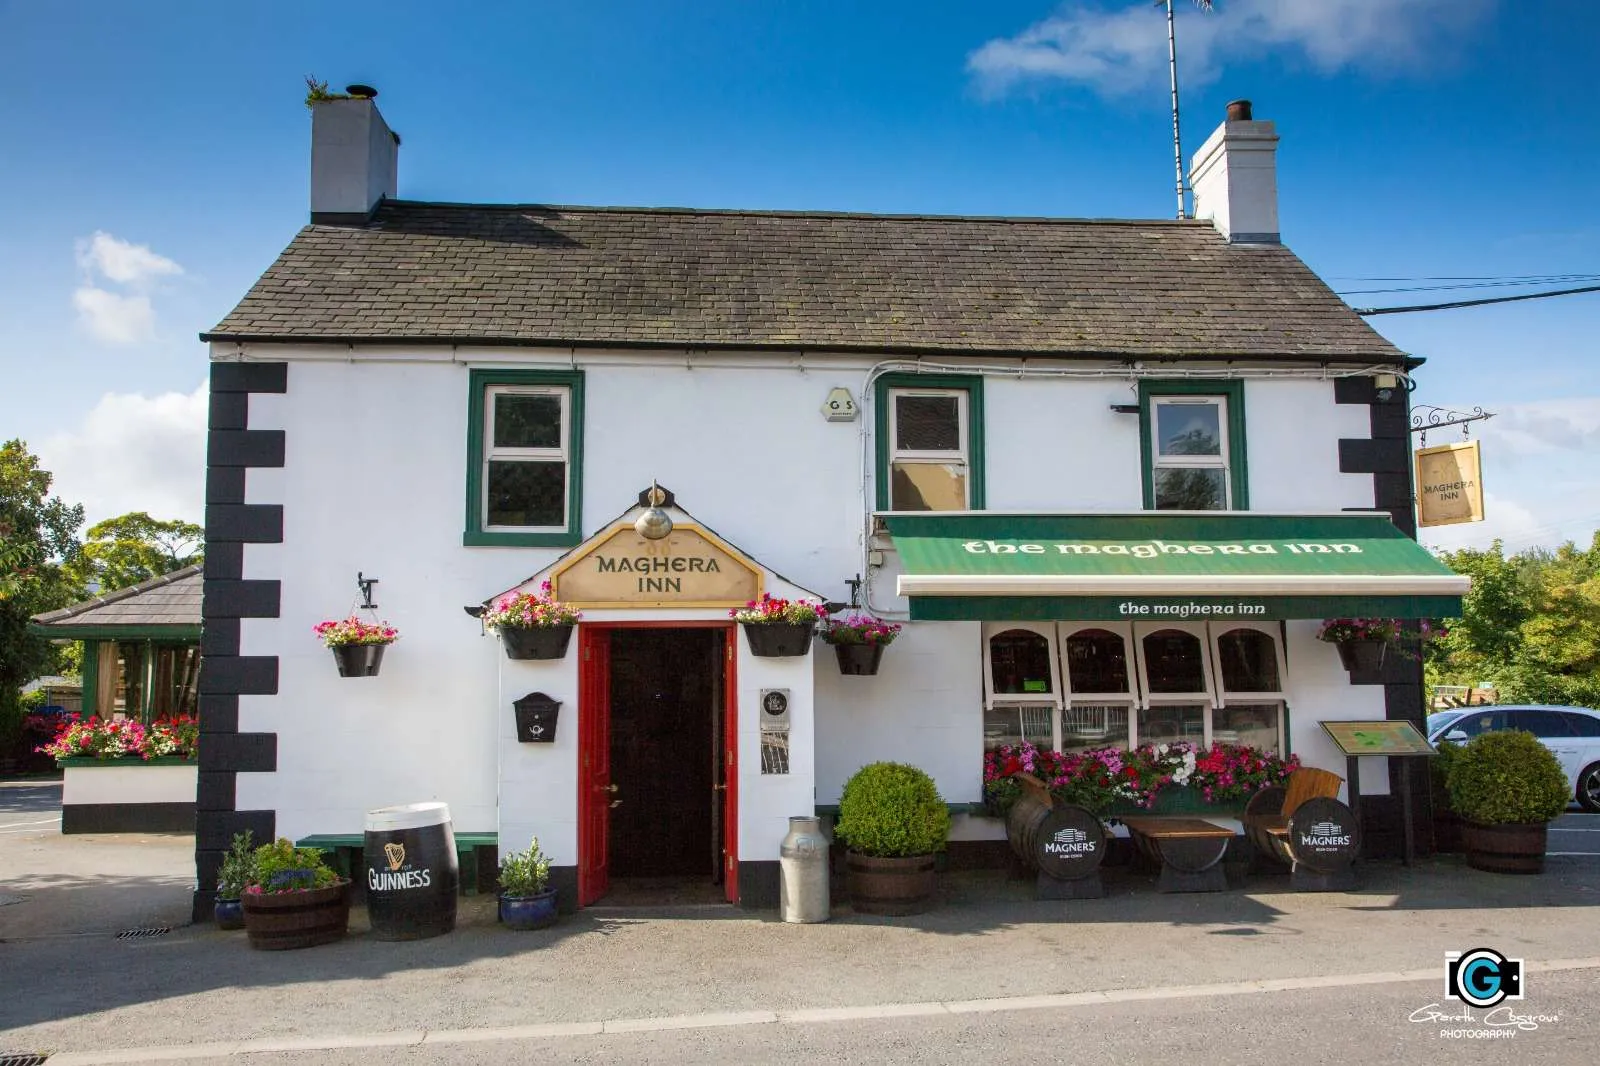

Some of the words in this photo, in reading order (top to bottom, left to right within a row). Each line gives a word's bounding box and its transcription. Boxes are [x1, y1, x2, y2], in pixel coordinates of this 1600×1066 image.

[1423, 480, 1475, 494] MAGHERA
[1440, 491, 1459, 501] INN
[962, 540, 1046, 554] the
[1054, 540, 1278, 558] maghera
[1284, 543, 1363, 554] inn
[596, 555, 721, 575] MAGHERA
[638, 577, 681, 593] INN
[1119, 602, 1150, 615] the
[1153, 602, 1235, 617] maghera
[1238, 603, 1266, 615] inn
[1045, 841, 1096, 853] MAGNERS
[1301, 835, 1350, 846] MAGNERS
[368, 867, 431, 891] GUINNESS
